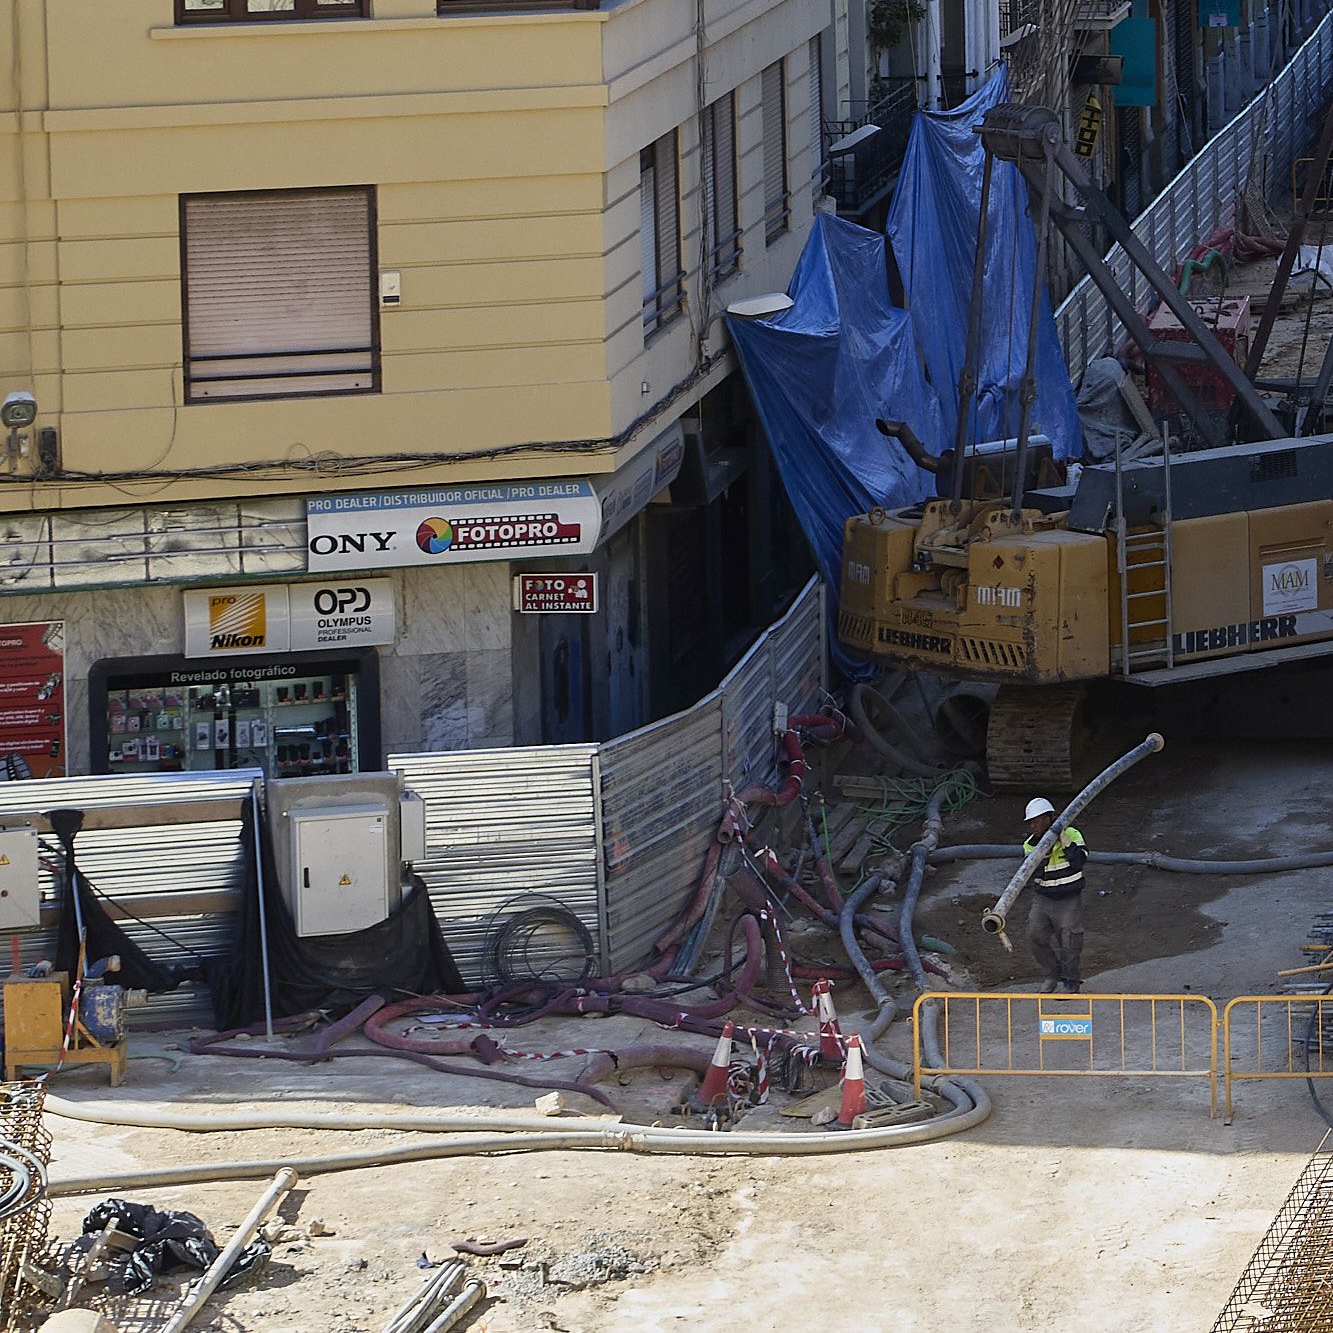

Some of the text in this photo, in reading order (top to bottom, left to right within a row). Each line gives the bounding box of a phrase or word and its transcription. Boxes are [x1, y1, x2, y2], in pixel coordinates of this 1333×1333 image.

[308, 500, 331, 511] PRO
[464, 489, 503, 502] OFICIAL
[539, 484, 580, 496] DEALER
[457, 522, 558, 543] FOTOPRO
[1271, 570, 1309, 590] MAM
[212, 595, 237, 607] pro
[525, 593, 565, 601] CARNET
[541, 602, 591, 610] INSTANTE
[318, 616, 372, 628] OLYMPUS
[318, 627, 372, 635] PROFESSIONAL
[1173, 615, 1297, 654] LIEBHERR
[211, 634, 265, 649] Nikon
[878, 626, 953, 653] LIEBHERR
[171, 665, 296, 682] Revelado fotográfico
[1056, 1023, 1089, 1033] rover
